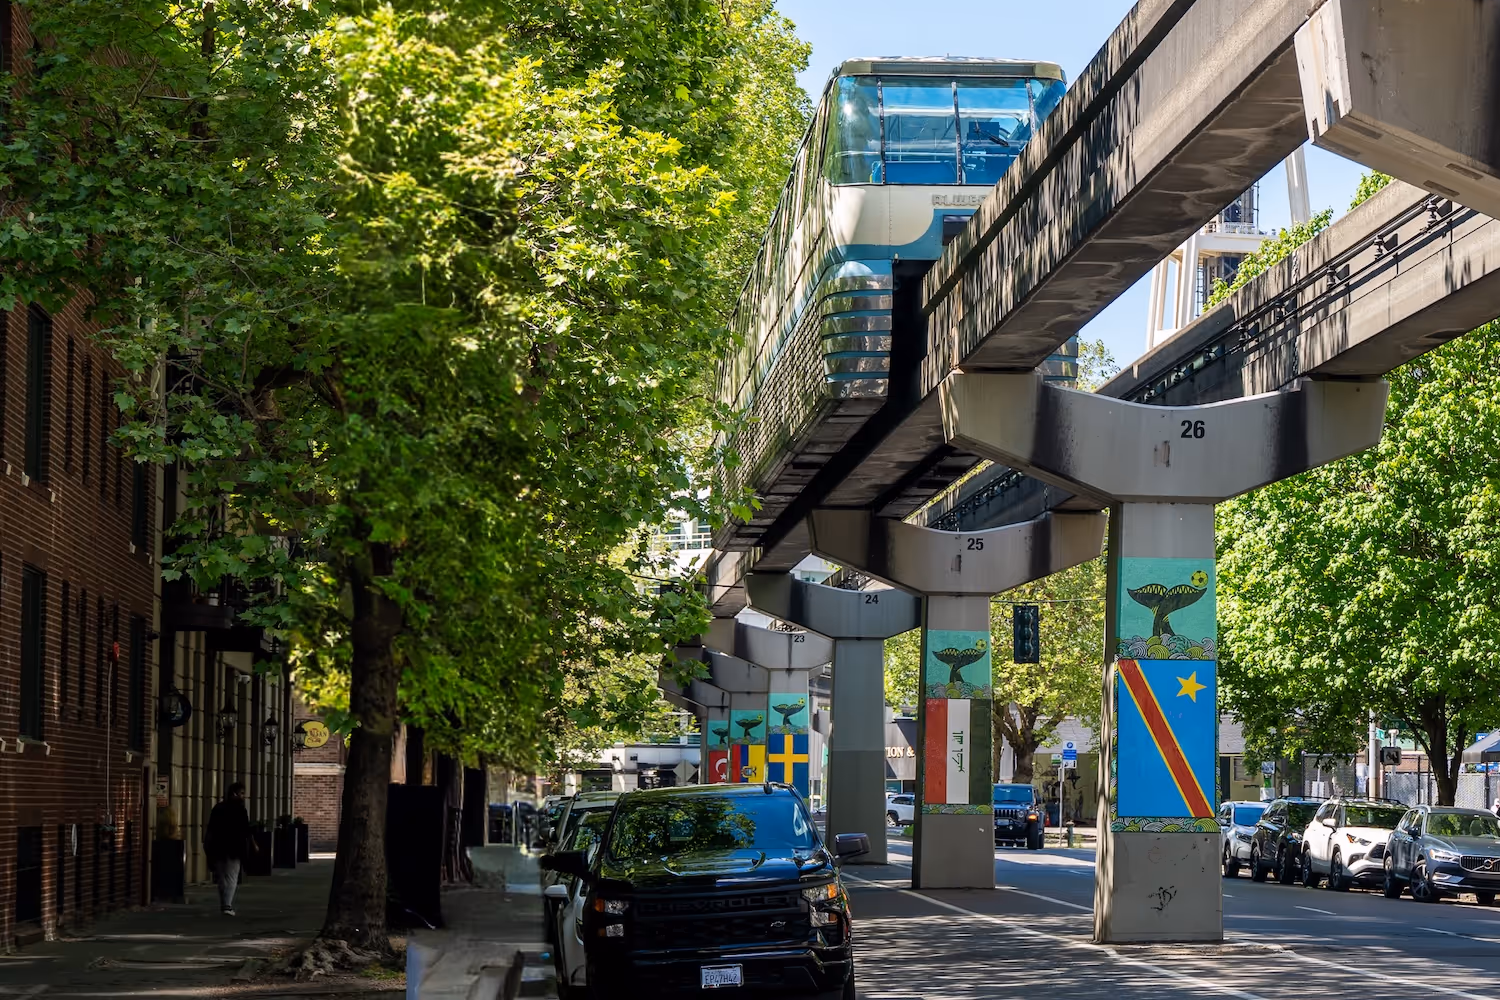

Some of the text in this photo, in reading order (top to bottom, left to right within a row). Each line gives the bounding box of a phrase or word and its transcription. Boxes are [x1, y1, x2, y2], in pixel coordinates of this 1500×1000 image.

[1181, 420, 1206, 439] 26
[967, 538, 983, 551] 25
[865, 594, 879, 604] 24
[794, 635, 805, 643] 23
